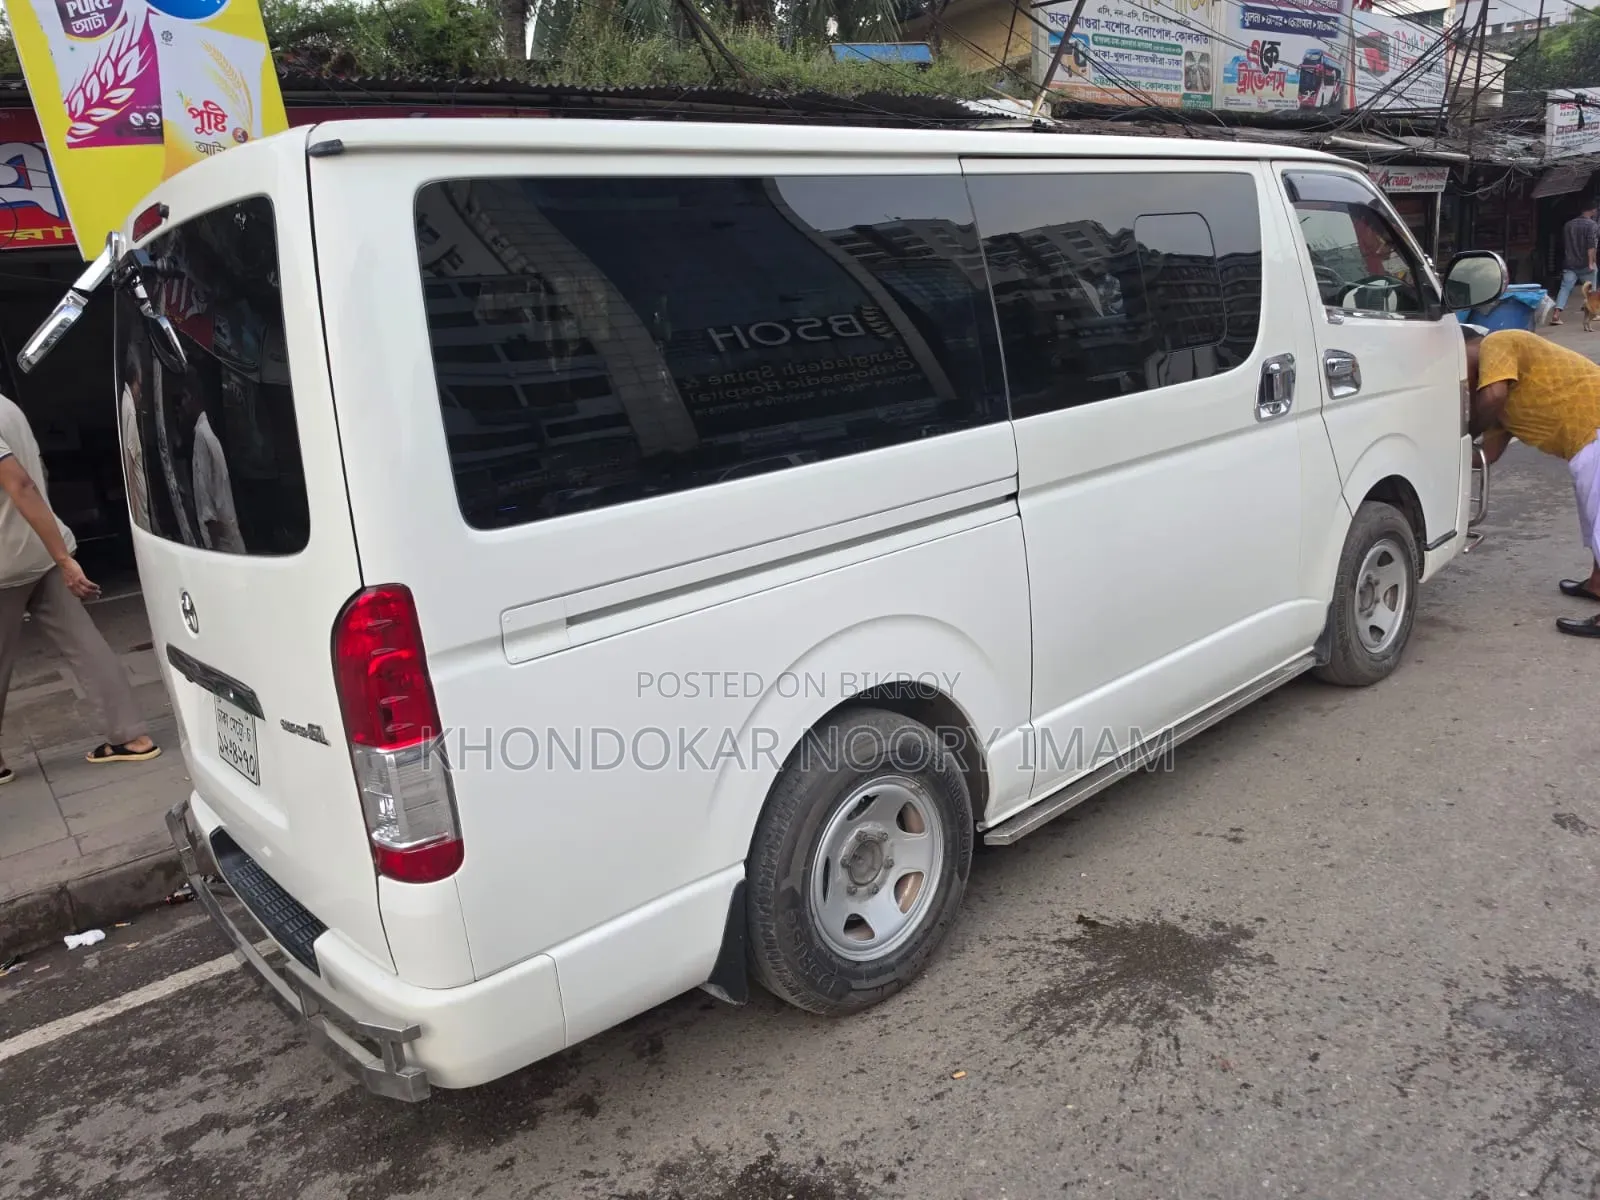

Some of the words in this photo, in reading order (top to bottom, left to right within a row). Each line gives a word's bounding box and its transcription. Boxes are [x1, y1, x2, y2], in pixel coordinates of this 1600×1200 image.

[71, 12, 107, 34] আটা
[1246, 39, 1281, 75] একে
[188, 100, 228, 136] পুষ্টি
